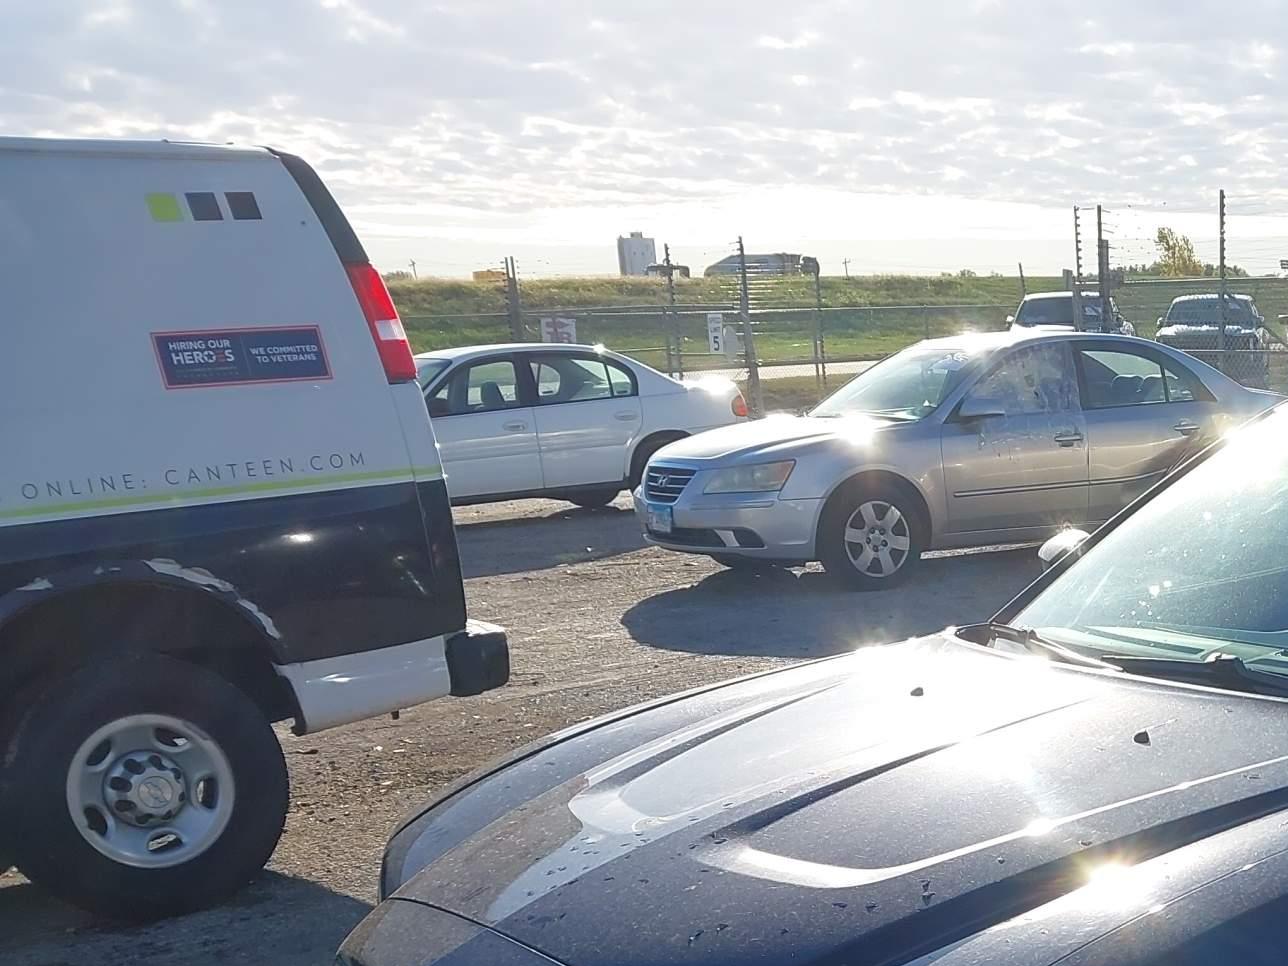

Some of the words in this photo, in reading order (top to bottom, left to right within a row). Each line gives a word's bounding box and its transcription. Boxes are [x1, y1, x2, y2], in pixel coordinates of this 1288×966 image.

[168, 340, 206, 350] HIRING
[207, 339, 231, 348] OUR
[250, 347, 267, 355] WE
[267, 344, 318, 354] COMMITTED
[713, 335, 720, 351] 5
[171, 349, 235, 365] HEROES
[256, 355, 270, 364] TO
[270, 353, 317, 363] VETERANS
[21, 474, 147, 499] ONLINE:
[164, 452, 366, 485] CANTEEN.COM
